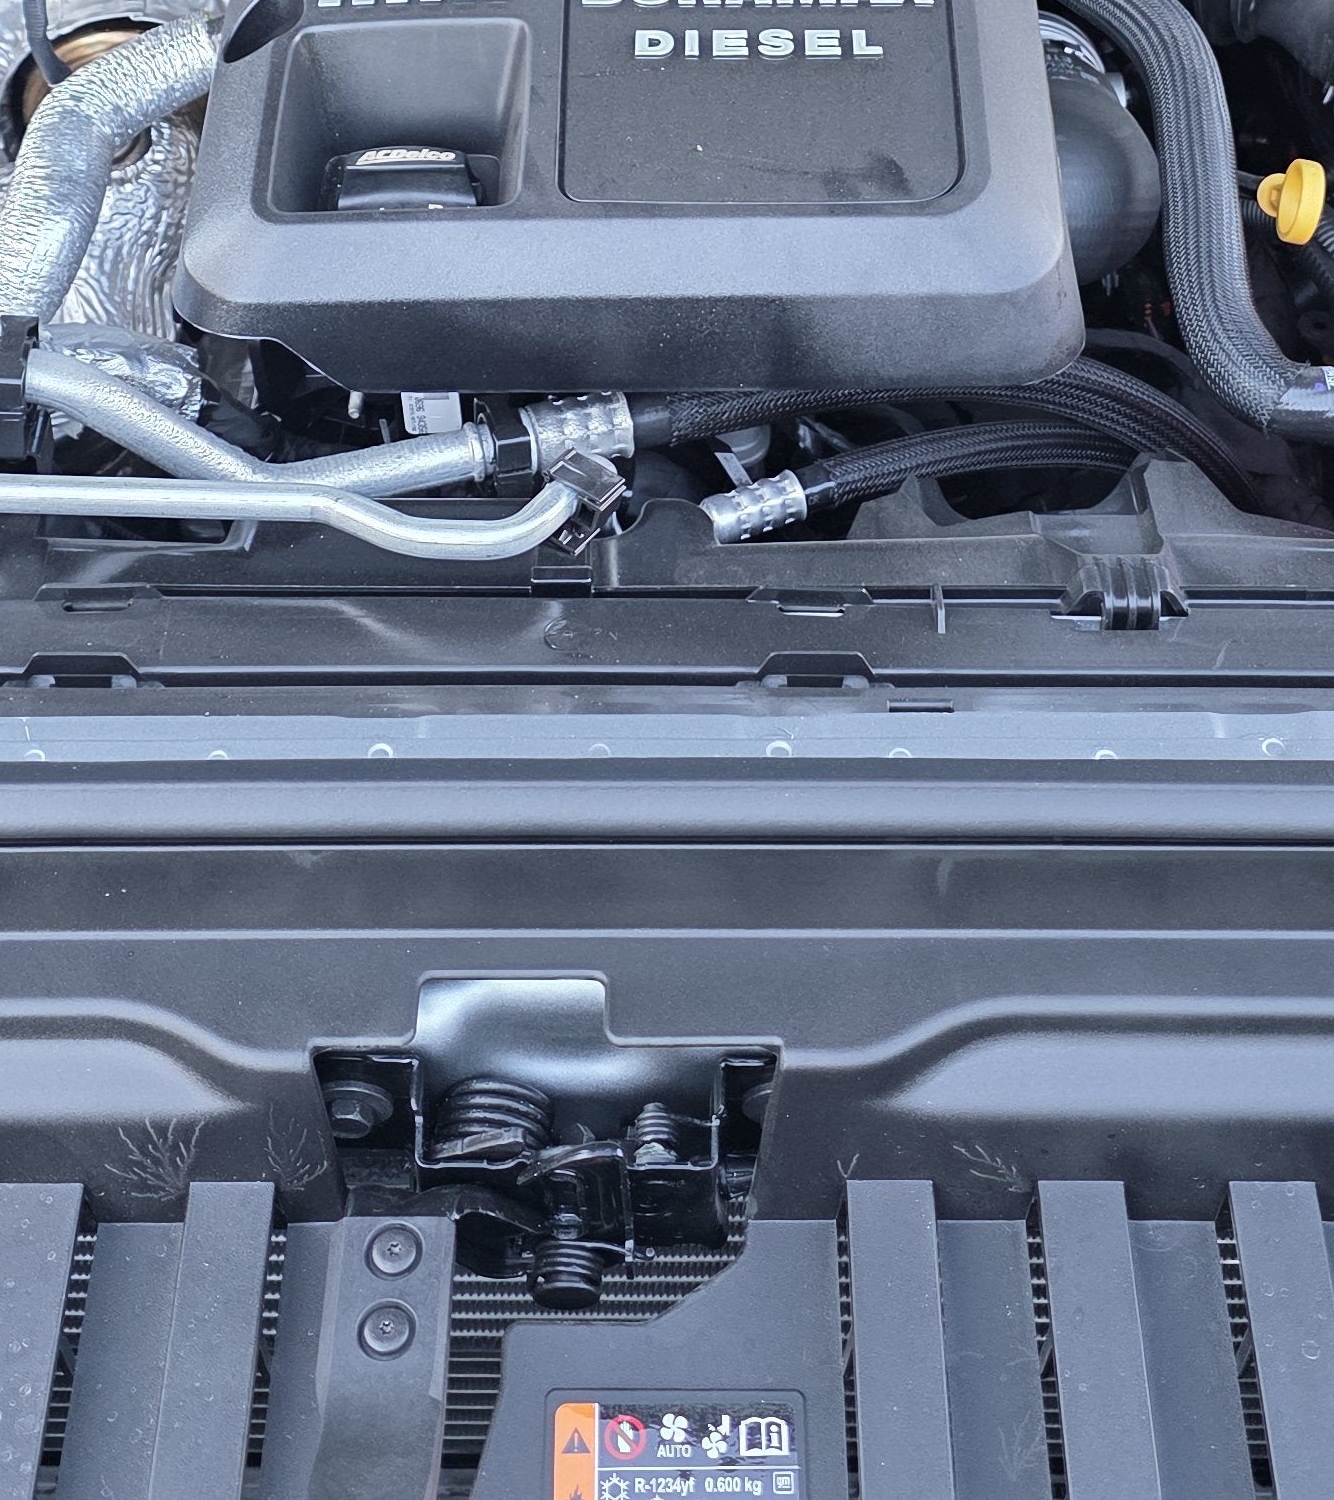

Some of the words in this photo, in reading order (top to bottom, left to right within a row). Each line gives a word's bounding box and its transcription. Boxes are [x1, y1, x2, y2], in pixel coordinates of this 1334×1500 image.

[634, 29, 883, 59] DIESEL
[356, 148, 457, 165] ACDelco
[656, 1444, 692, 1458] AUTO
[634, 1476, 696, 1497] R-1234yf
[704, 1476, 742, 1493] 0.600
[744, 1476, 763, 1497] kg
